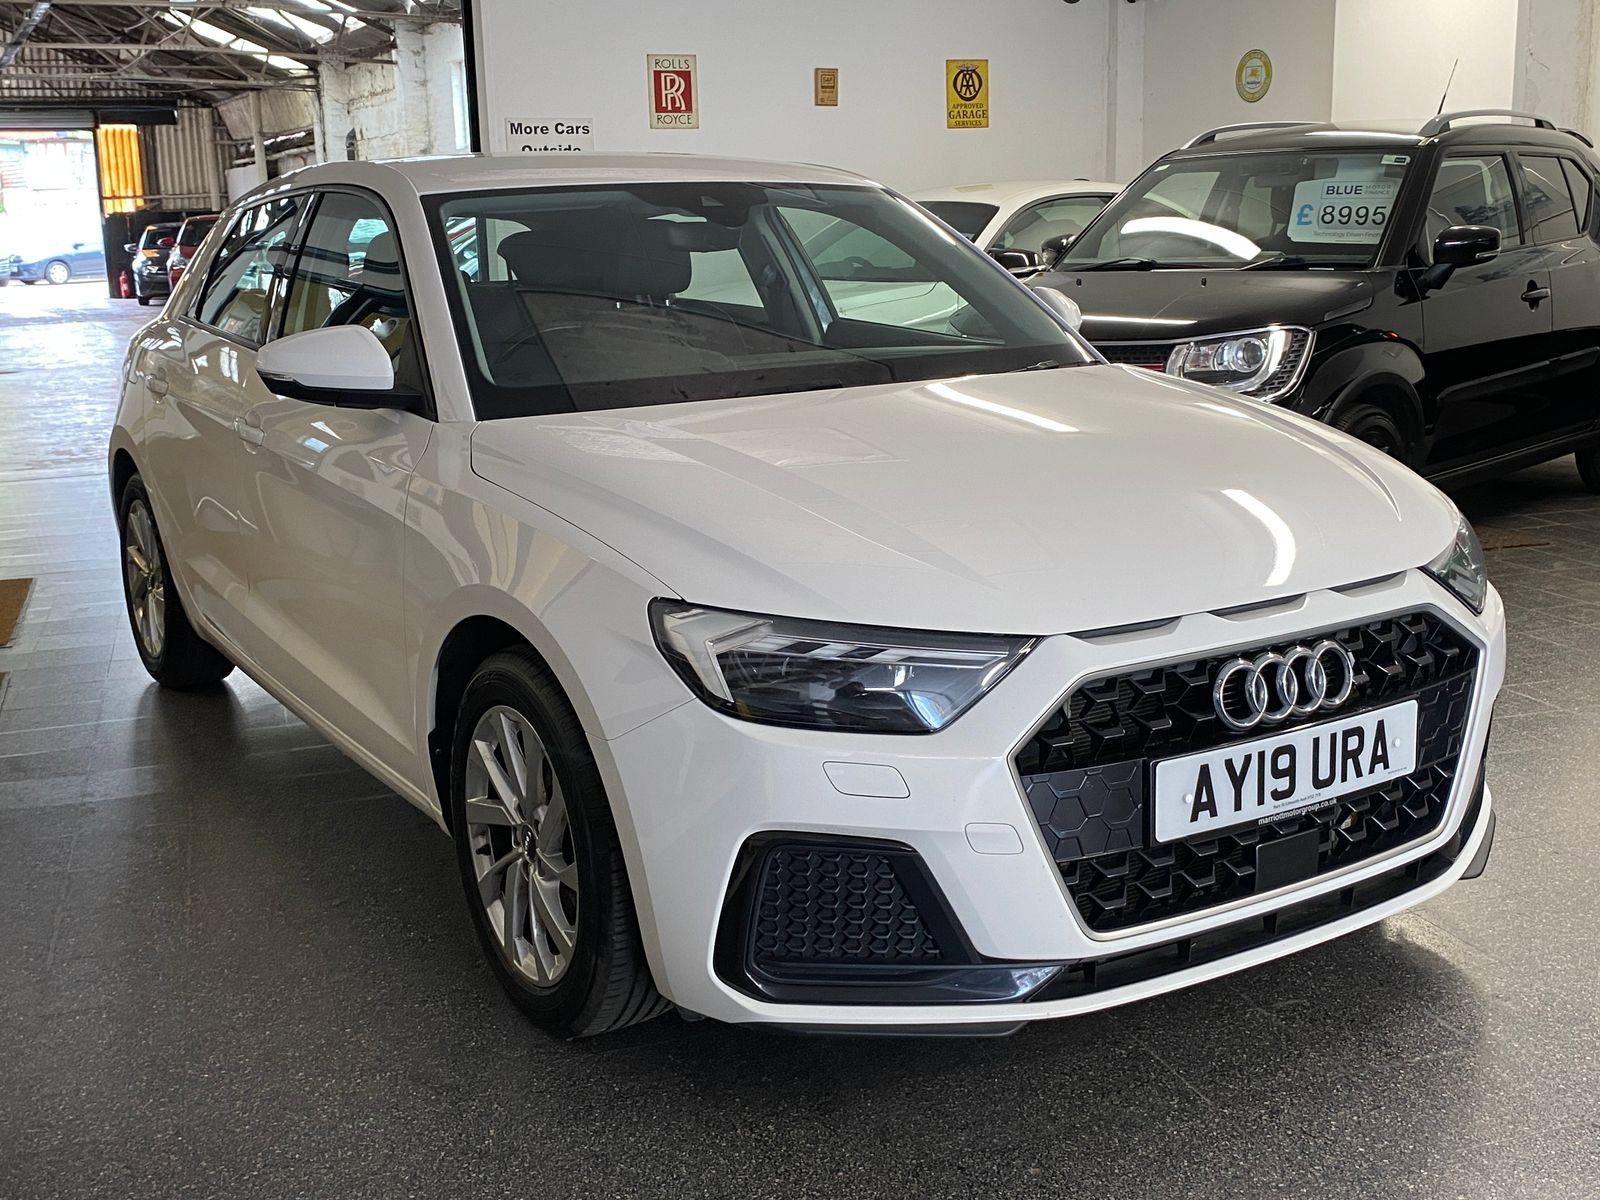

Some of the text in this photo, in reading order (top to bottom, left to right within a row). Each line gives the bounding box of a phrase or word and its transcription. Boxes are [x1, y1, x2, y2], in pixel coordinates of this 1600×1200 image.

[654, 58, 690, 69] ROLLS
[656, 114, 692, 125] ROYCE
[948, 109, 988, 119] GARAGE
[510, 122, 590, 135] More Cars
[1325, 185, 1364, 195] BLUE
[1296, 203, 1387, 226] £ 8995
[1189, 718, 1390, 822] AY19 URA
[1257, 797, 1338, 825] marriottmotorgroup.co.uk
